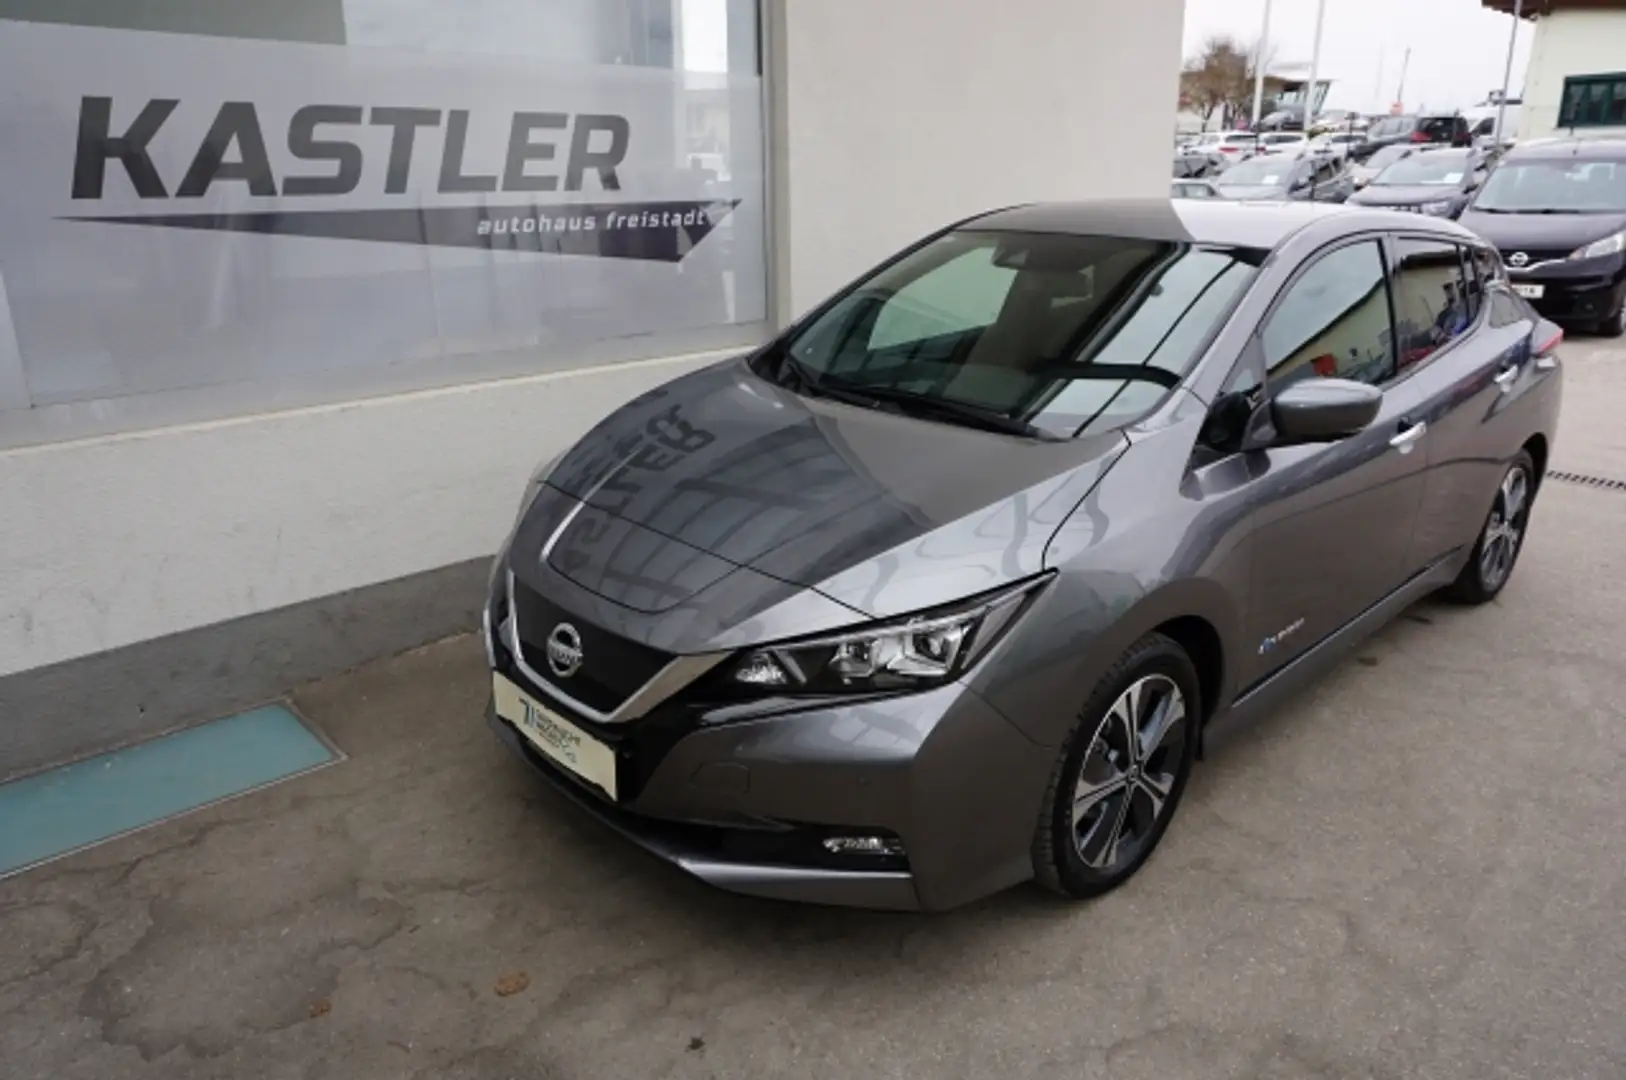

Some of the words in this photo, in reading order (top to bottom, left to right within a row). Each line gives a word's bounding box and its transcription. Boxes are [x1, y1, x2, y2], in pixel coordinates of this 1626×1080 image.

[71, 96, 630, 199] KASTLER
[478, 215, 596, 235] autohaus
[606, 209, 706, 231] freistadt
